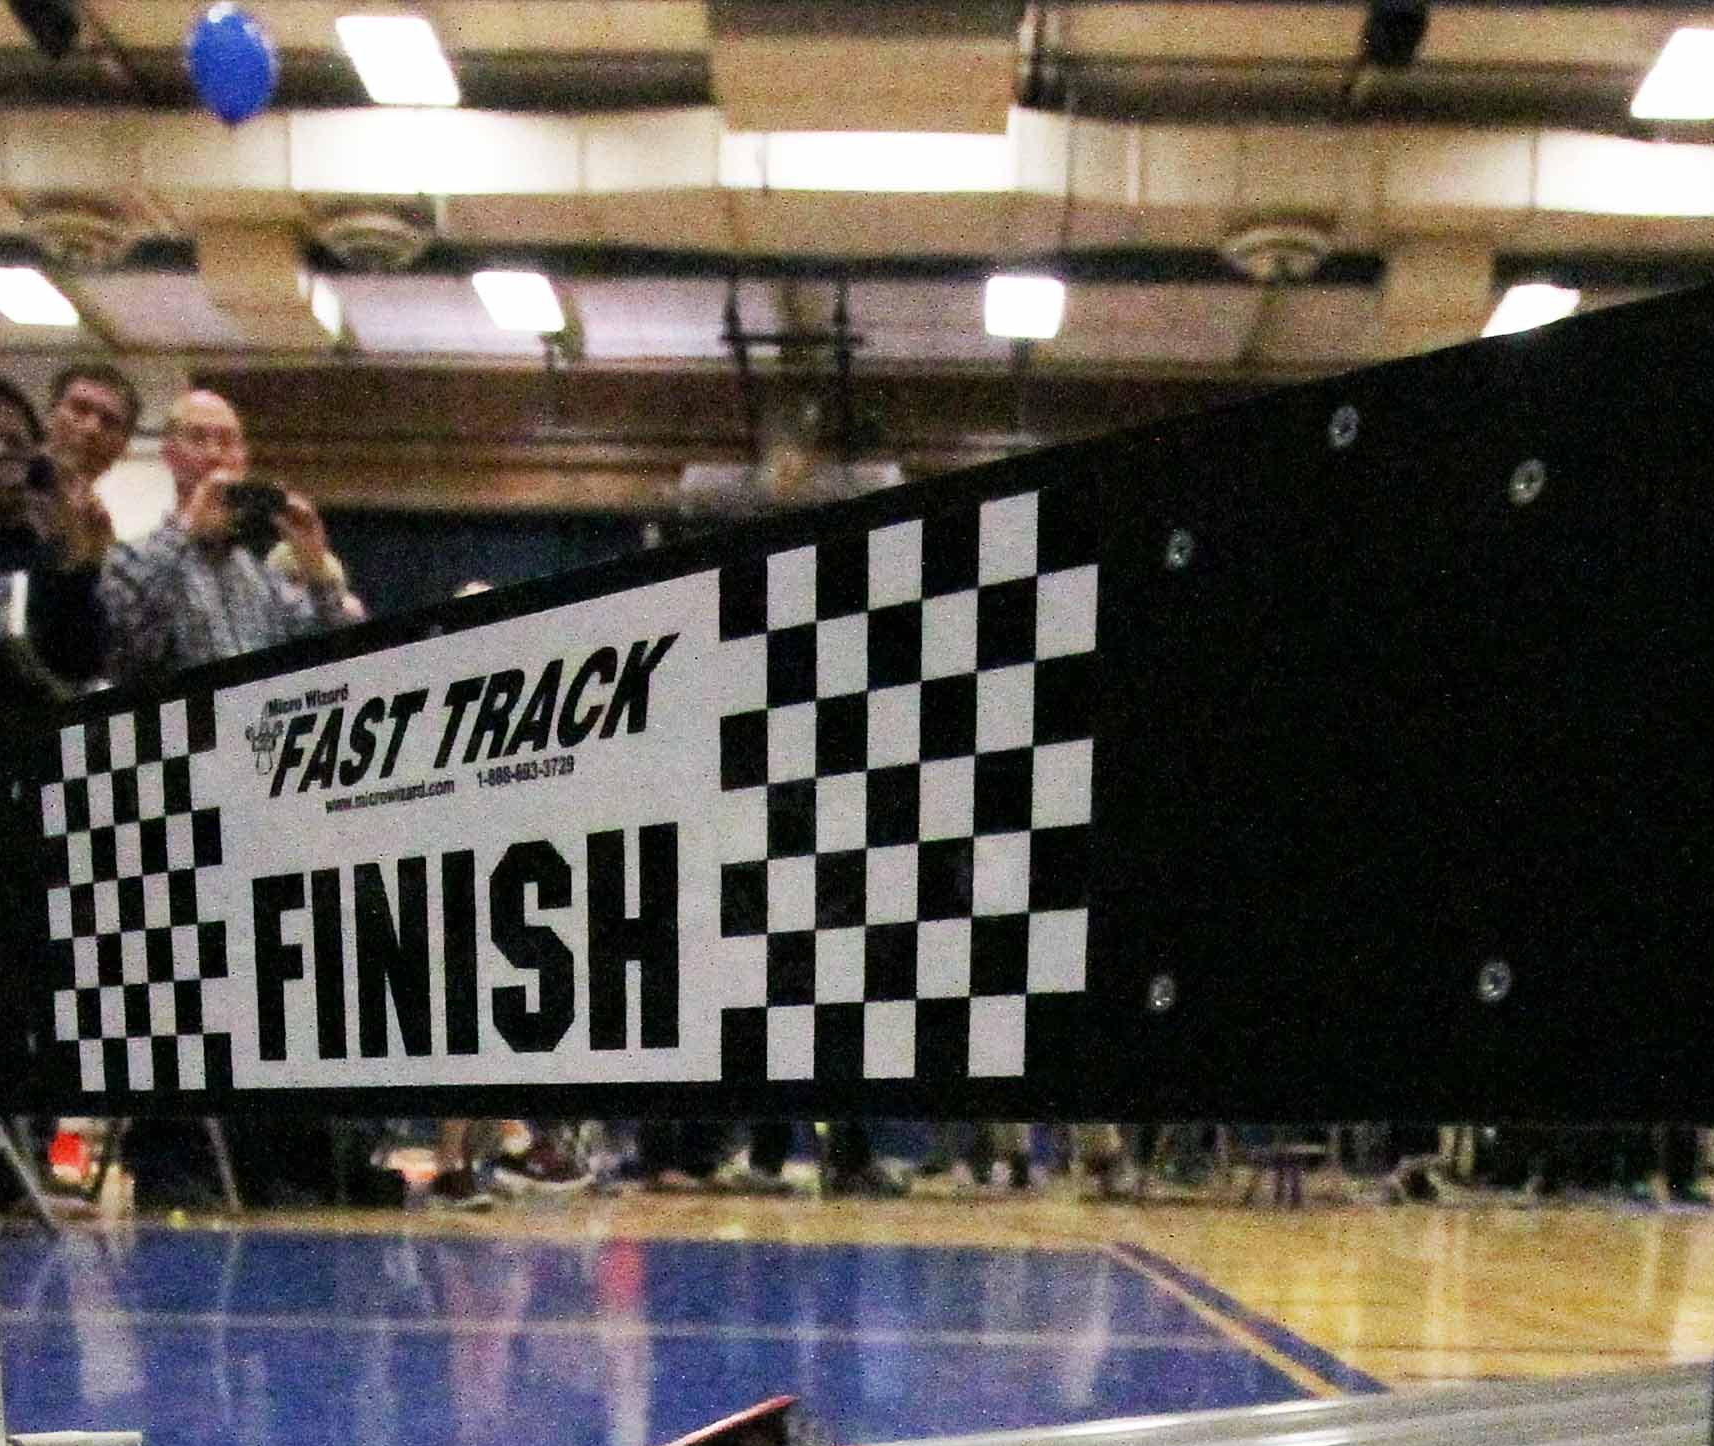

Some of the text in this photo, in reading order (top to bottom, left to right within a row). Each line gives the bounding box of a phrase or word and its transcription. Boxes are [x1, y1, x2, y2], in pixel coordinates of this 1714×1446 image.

[305, 683, 348, 708] Wizard
[269, 631, 680, 799] FAST TRACK
[476, 755, 575, 788] 1-888-693-3729
[325, 779, 455, 814] www.microwizard.com
[252, 822, 679, 1061] FINISH
